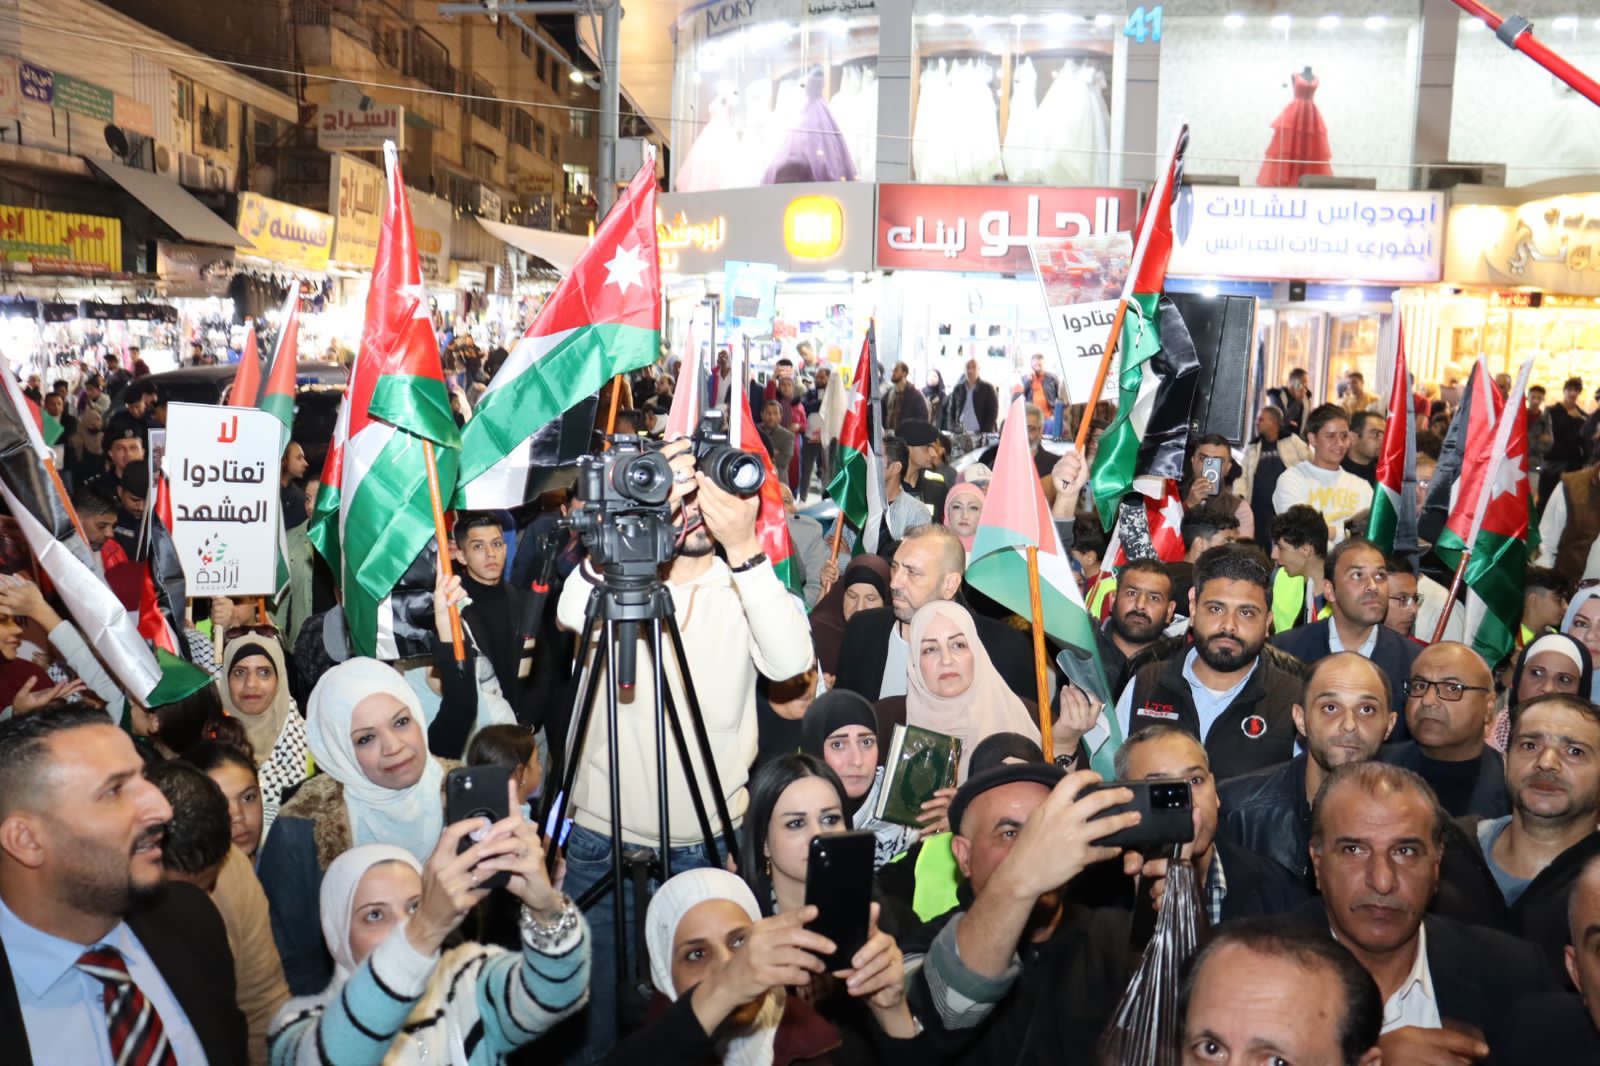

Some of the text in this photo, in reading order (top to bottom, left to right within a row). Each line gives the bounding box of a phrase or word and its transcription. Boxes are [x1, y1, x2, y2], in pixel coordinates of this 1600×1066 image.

[1123, 5, 1163, 43] 41
[323, 109, 396, 131] السراج
[1206, 193, 1306, 218] للشالات
[887, 194, 1120, 259] الحلو لينك
[1062, 309, 1117, 333] عتادوا
[217, 415, 238, 443] لا
[183, 458, 264, 487] تعتادوا
[176, 495, 267, 524] المشهد
[196, 566, 239, 589] إرادة
